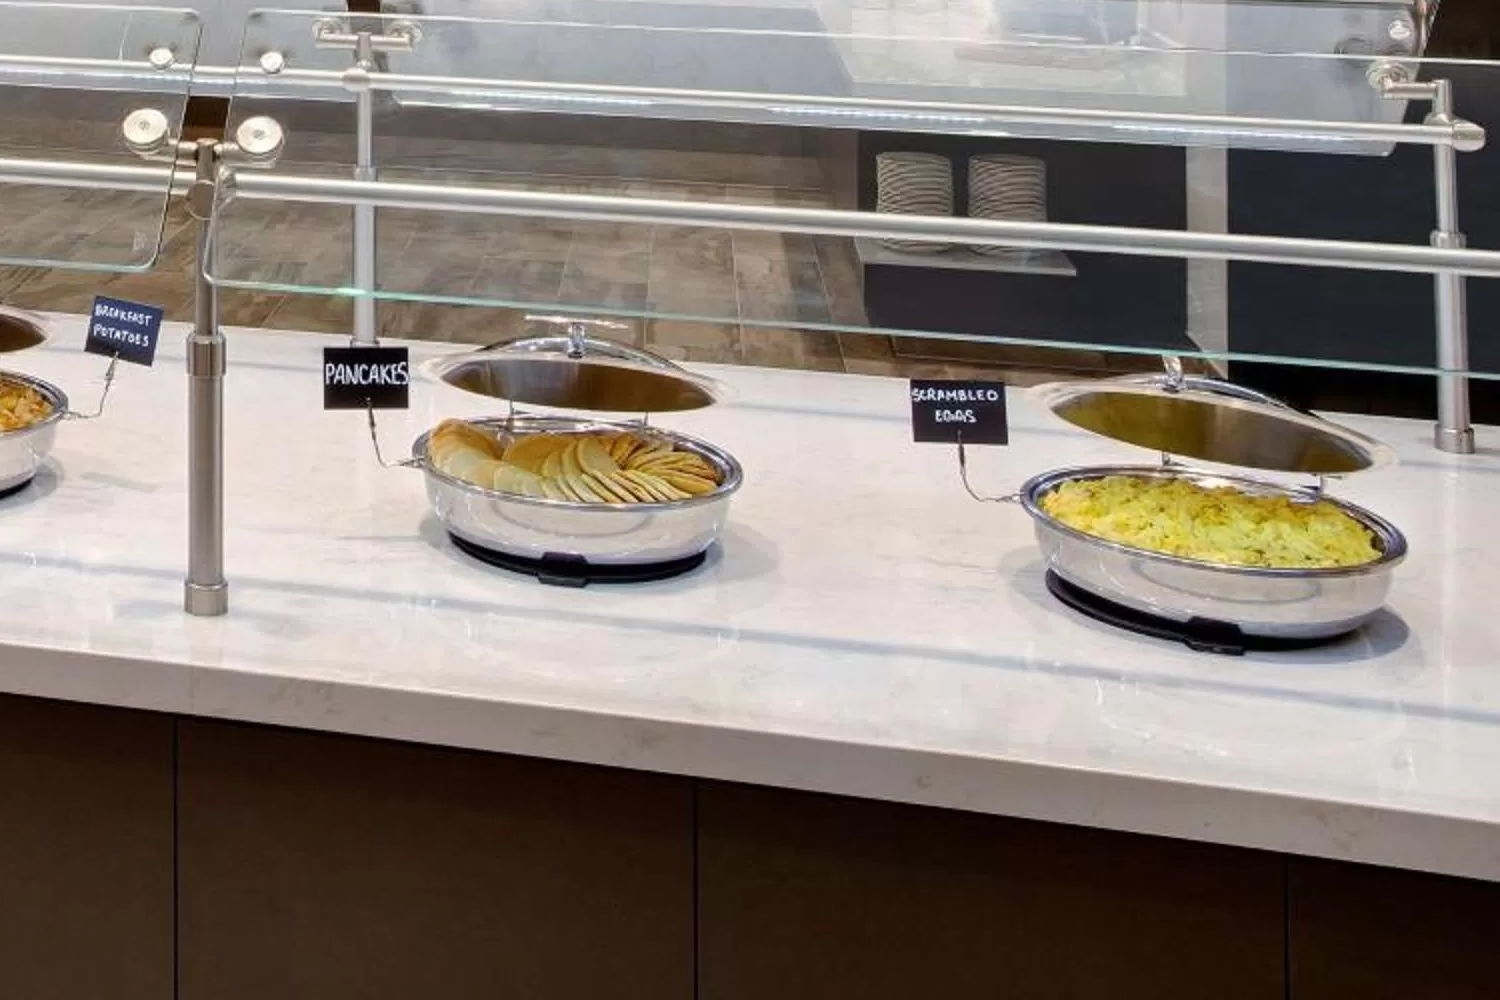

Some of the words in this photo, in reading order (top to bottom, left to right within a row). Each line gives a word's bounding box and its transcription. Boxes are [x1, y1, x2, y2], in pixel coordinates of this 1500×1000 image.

[94, 303, 153, 327] BREAKFAST
[92, 323, 150, 348] POTATOES
[325, 361, 410, 385] PANCAKES
[935, 409, 977, 423] EGGS
